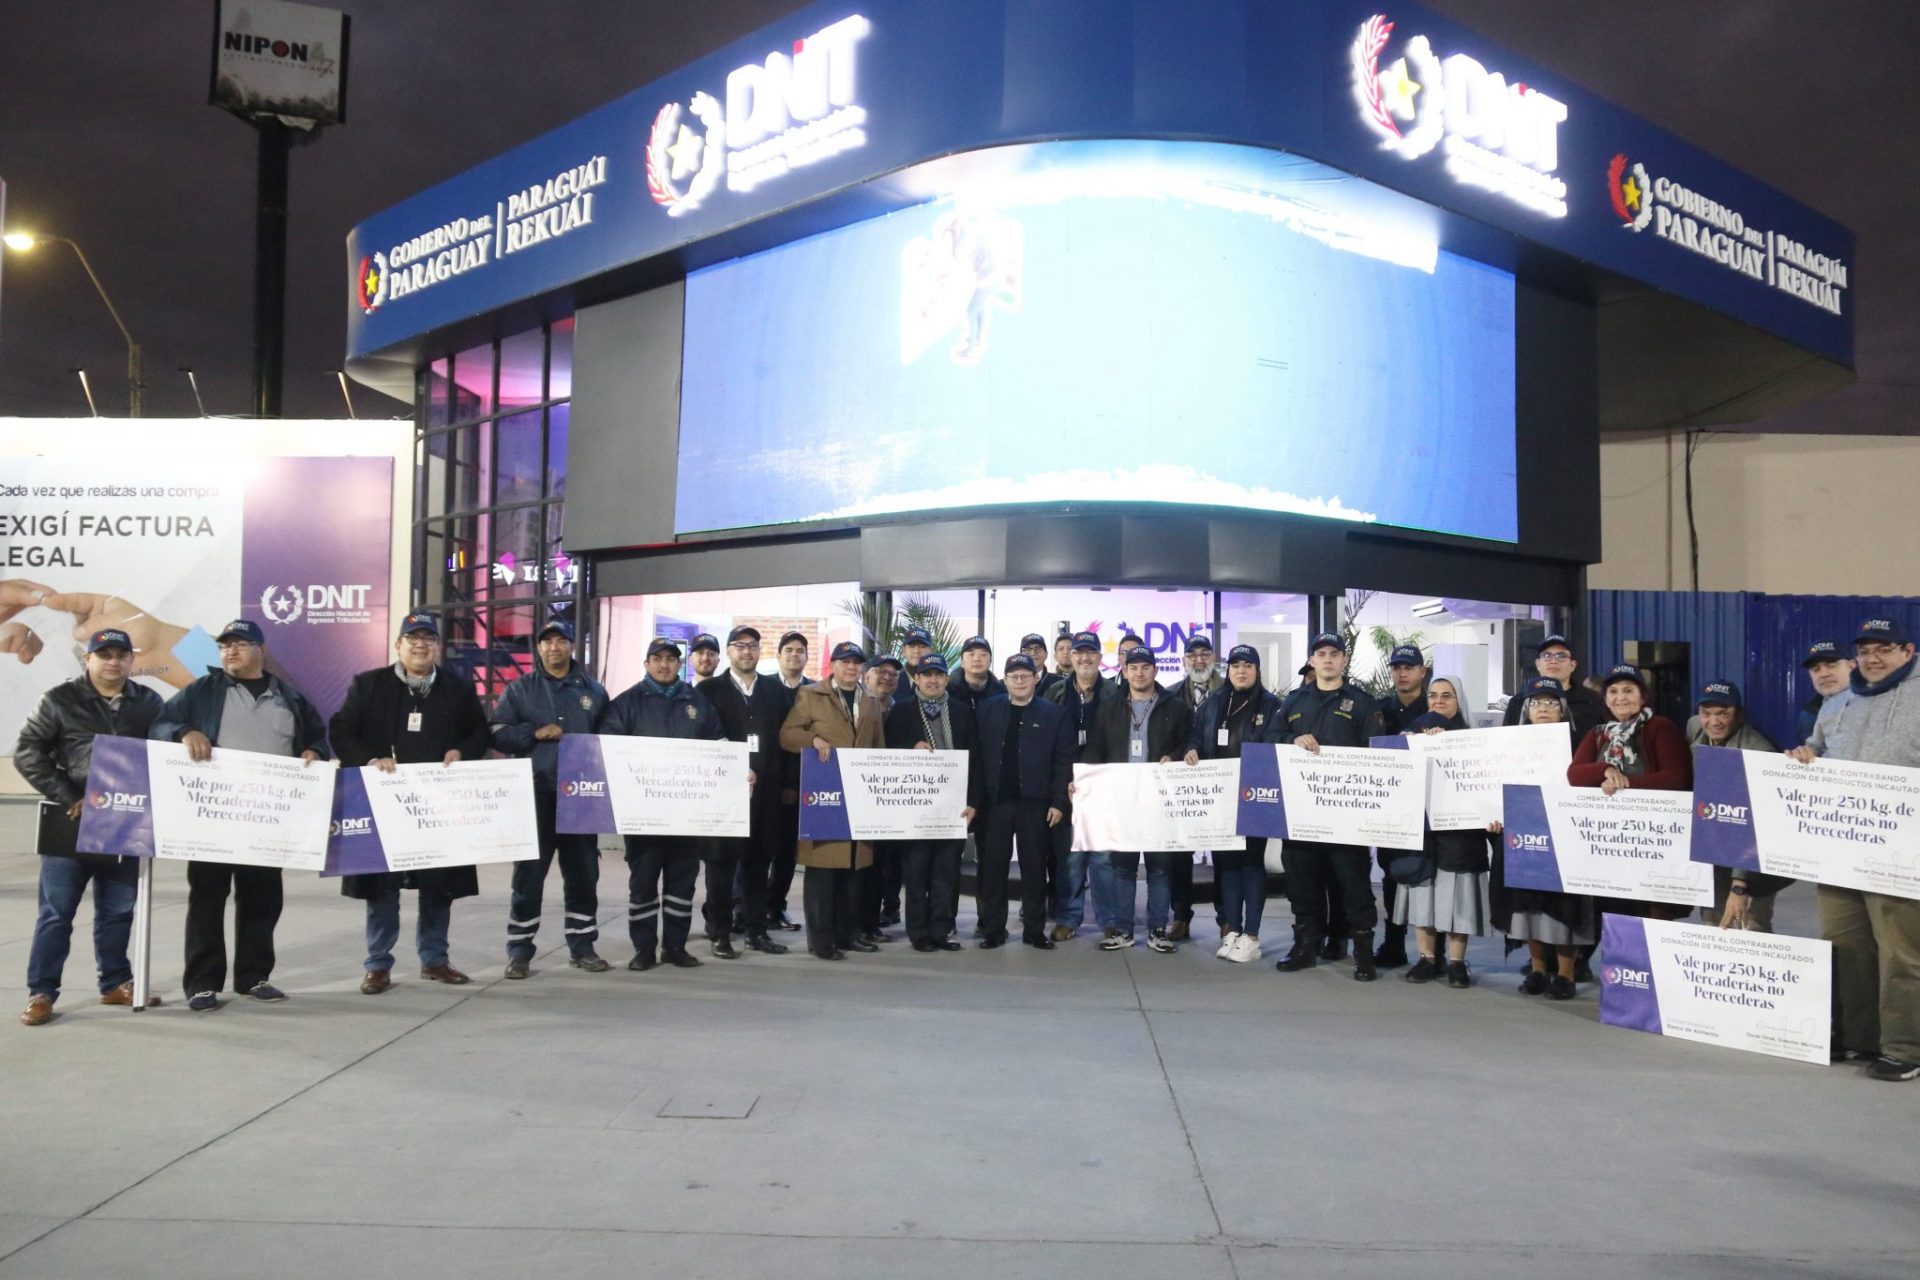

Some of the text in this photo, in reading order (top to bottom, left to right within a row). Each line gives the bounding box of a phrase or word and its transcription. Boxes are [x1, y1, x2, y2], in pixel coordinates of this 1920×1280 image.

[224, 31, 308, 62] NIPON
[726, 14, 870, 148] DNIT
[1442, 53, 1568, 173] DNIT
[507, 155, 607, 221] PARAGUÁI
[1655, 177, 1765, 248] GOBIERNO DEL
[505, 192, 594, 255] REKUÁI
[390, 214, 494, 268] GOBIERNO DEL
[1655, 205, 1765, 281] PARAGUAY
[389, 234, 492, 300] PARAGUAY
[1776, 234, 1847, 288] PARAGUÁI
[1777, 262, 1842, 315] REKUÁI
[0, 484, 28, 497] Cada
[32, 487, 56, 497] vez
[60, 487, 85, 500] que
[140, 487, 165, 497] una
[79, 515, 215, 537] FACTURA
[307, 584, 372, 609] DNIT
[307, 617, 335, 625] Ingresos
[1346, 754, 1396, 762] CONTRABANDO
[1372, 762, 1414, 770] INCAUTADOS
[1435, 757, 1459, 769] Vale
[627, 763, 650, 774] Vale
[652, 767, 670, 777] por
[673, 765, 695, 775] 250
[714, 766, 728, 777] de
[1175, 765, 1217, 773] CONTRABANDO
[1785, 763, 1825, 774] COMBATE
[1840, 769, 1907, 783] CONTRABANDO
[579, 781, 605, 791] DNIT
[704, 780, 717, 788] no
[861, 773, 949, 786] Vale por 250 kg. de
[1300, 771, 1402, 787] Vale por 250 kg. de
[1762, 769, 1807, 780] DONACIÓN
[1822, 776, 1872, 789] PRODUCTOS
[179, 775, 207, 789] Vale
[210, 782, 235, 794] por
[238, 782, 265, 794] 250
[289, 788, 306, 800] de
[394, 791, 421, 804] Vale
[495, 787, 509, 798] de
[644, 787, 710, 800] Perecederas
[868, 785, 926, 795] Mercaderías
[1175, 784, 1224, 797] 250 kg. de
[1256, 787, 1279, 798] DNIT
[1307, 783, 1390, 798] Mercaderías no
[114, 793, 147, 806] DNIT
[186, 791, 290, 811] Mercaderías no
[819, 792, 842, 801] DNIT
[876, 796, 933, 806] Perecederas
[1202, 798, 1214, 806] no
[1315, 795, 1381, 809] Perecederas
[1621, 797, 1676, 805] CONTRABANDO
[1777, 787, 1915, 817] Vale por 250 kg. de
[197, 805, 280, 824] Perecederas
[483, 803, 498, 811] no
[1558, 800, 1594, 809] DONACIÓN
[1607, 804, 1649, 812] PRODUCTOS
[1651, 806, 1693, 814] INCAUTADO
[1717, 804, 1748, 818] DNIT
[342, 817, 371, 829] DNIT
[1571, 816, 1685, 835] Vale por 250 kg. de
[1786, 804, 1898, 831] Mercaderías no
[1524, 834, 1549, 846] DNIT
[1580, 830, 1672, 847] Mercaderías no
[1798, 820, 1886, 844] Perecederas
[1590, 844, 1664, 860] Perecederas
[1681, 931, 1715, 942] COMBATE
[1730, 938, 1791, 951] CONTRABANDO
[1661, 937, 1699, 948] DONACIÓN
[1713, 944, 1760, 956] PRODUCTOS
[1762, 951, 1814, 964] INCAUTADOS
[1623, 969, 1649, 983] DNIT
[1674, 954, 1799, 983] Vale por 250 kg. de
[1682, 969, 1784, 996] Mercaderías no
[1694, 986, 1775, 1009] Perecederas
